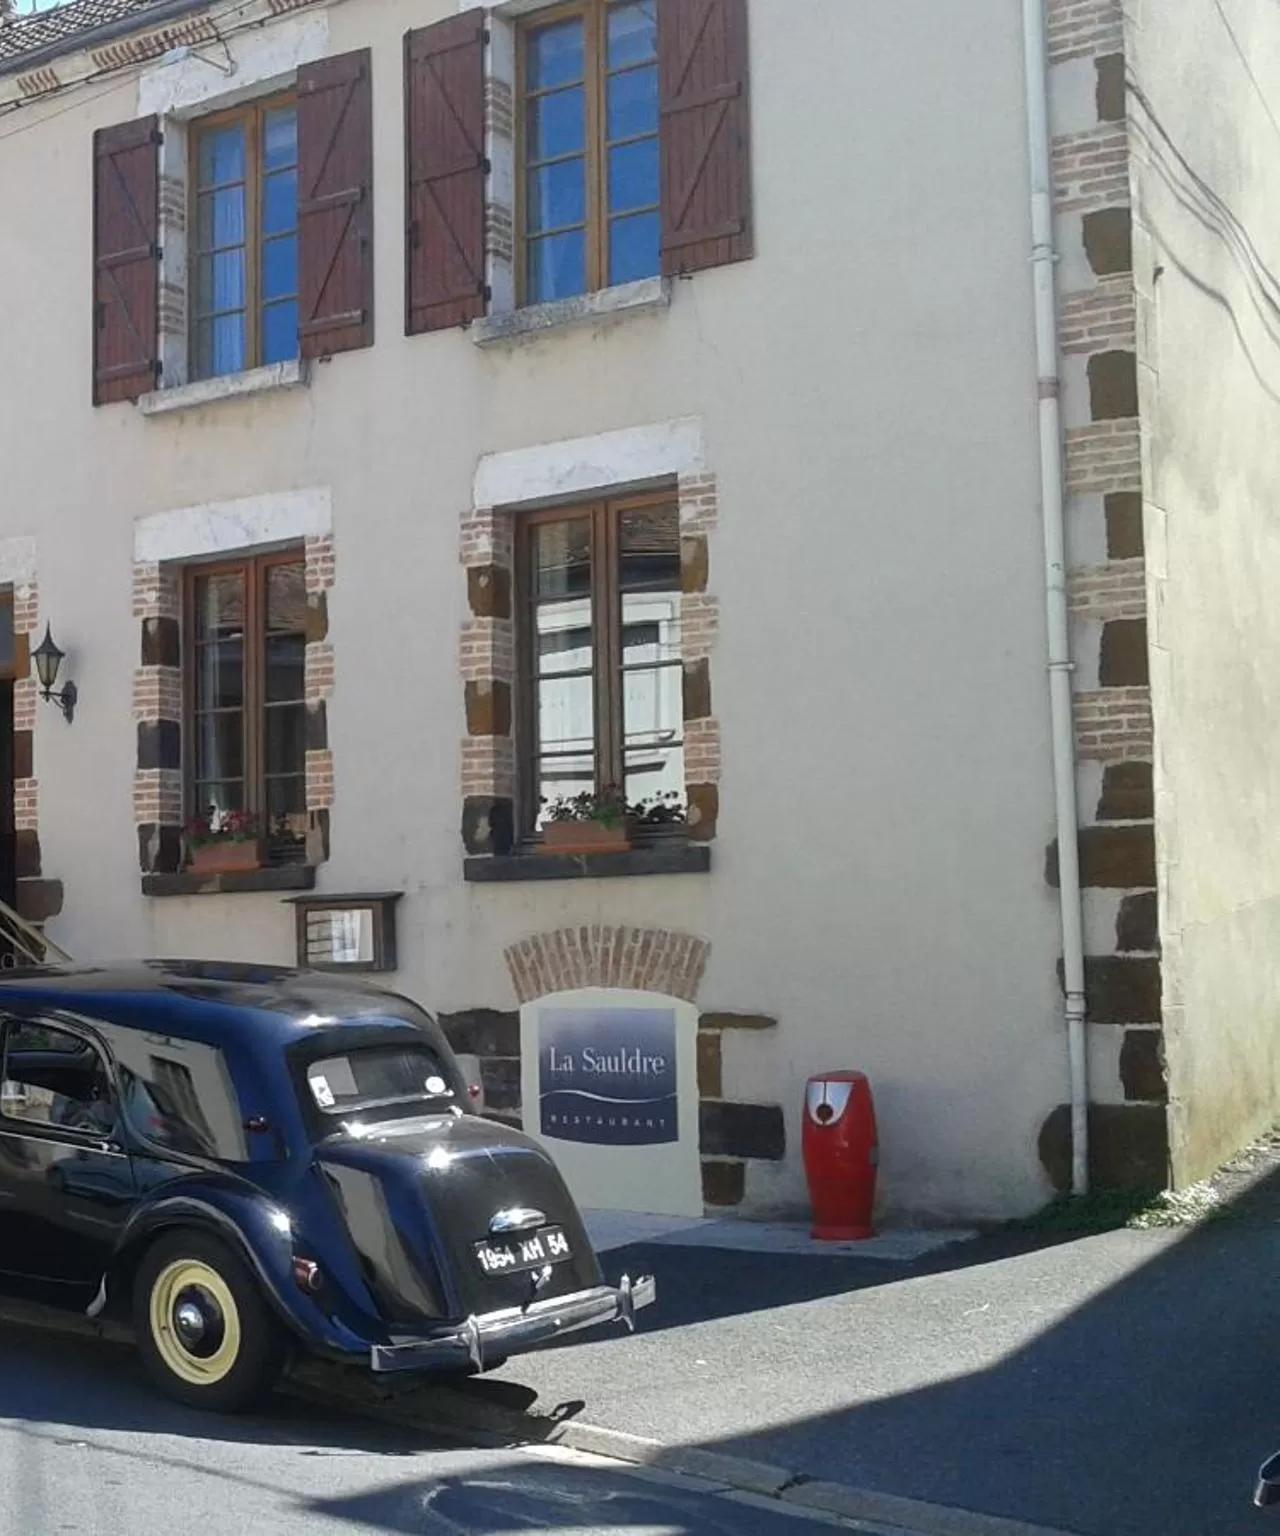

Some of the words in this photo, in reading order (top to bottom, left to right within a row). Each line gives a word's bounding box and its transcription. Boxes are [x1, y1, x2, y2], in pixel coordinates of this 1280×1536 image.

[549, 1046, 573, 1072] La
[582, 1047, 665, 1074] Sauldre
[550, 1114, 665, 1127] RESTAURANT
[477, 1246, 516, 1270] 1954
[547, 1232, 569, 1255] 54
